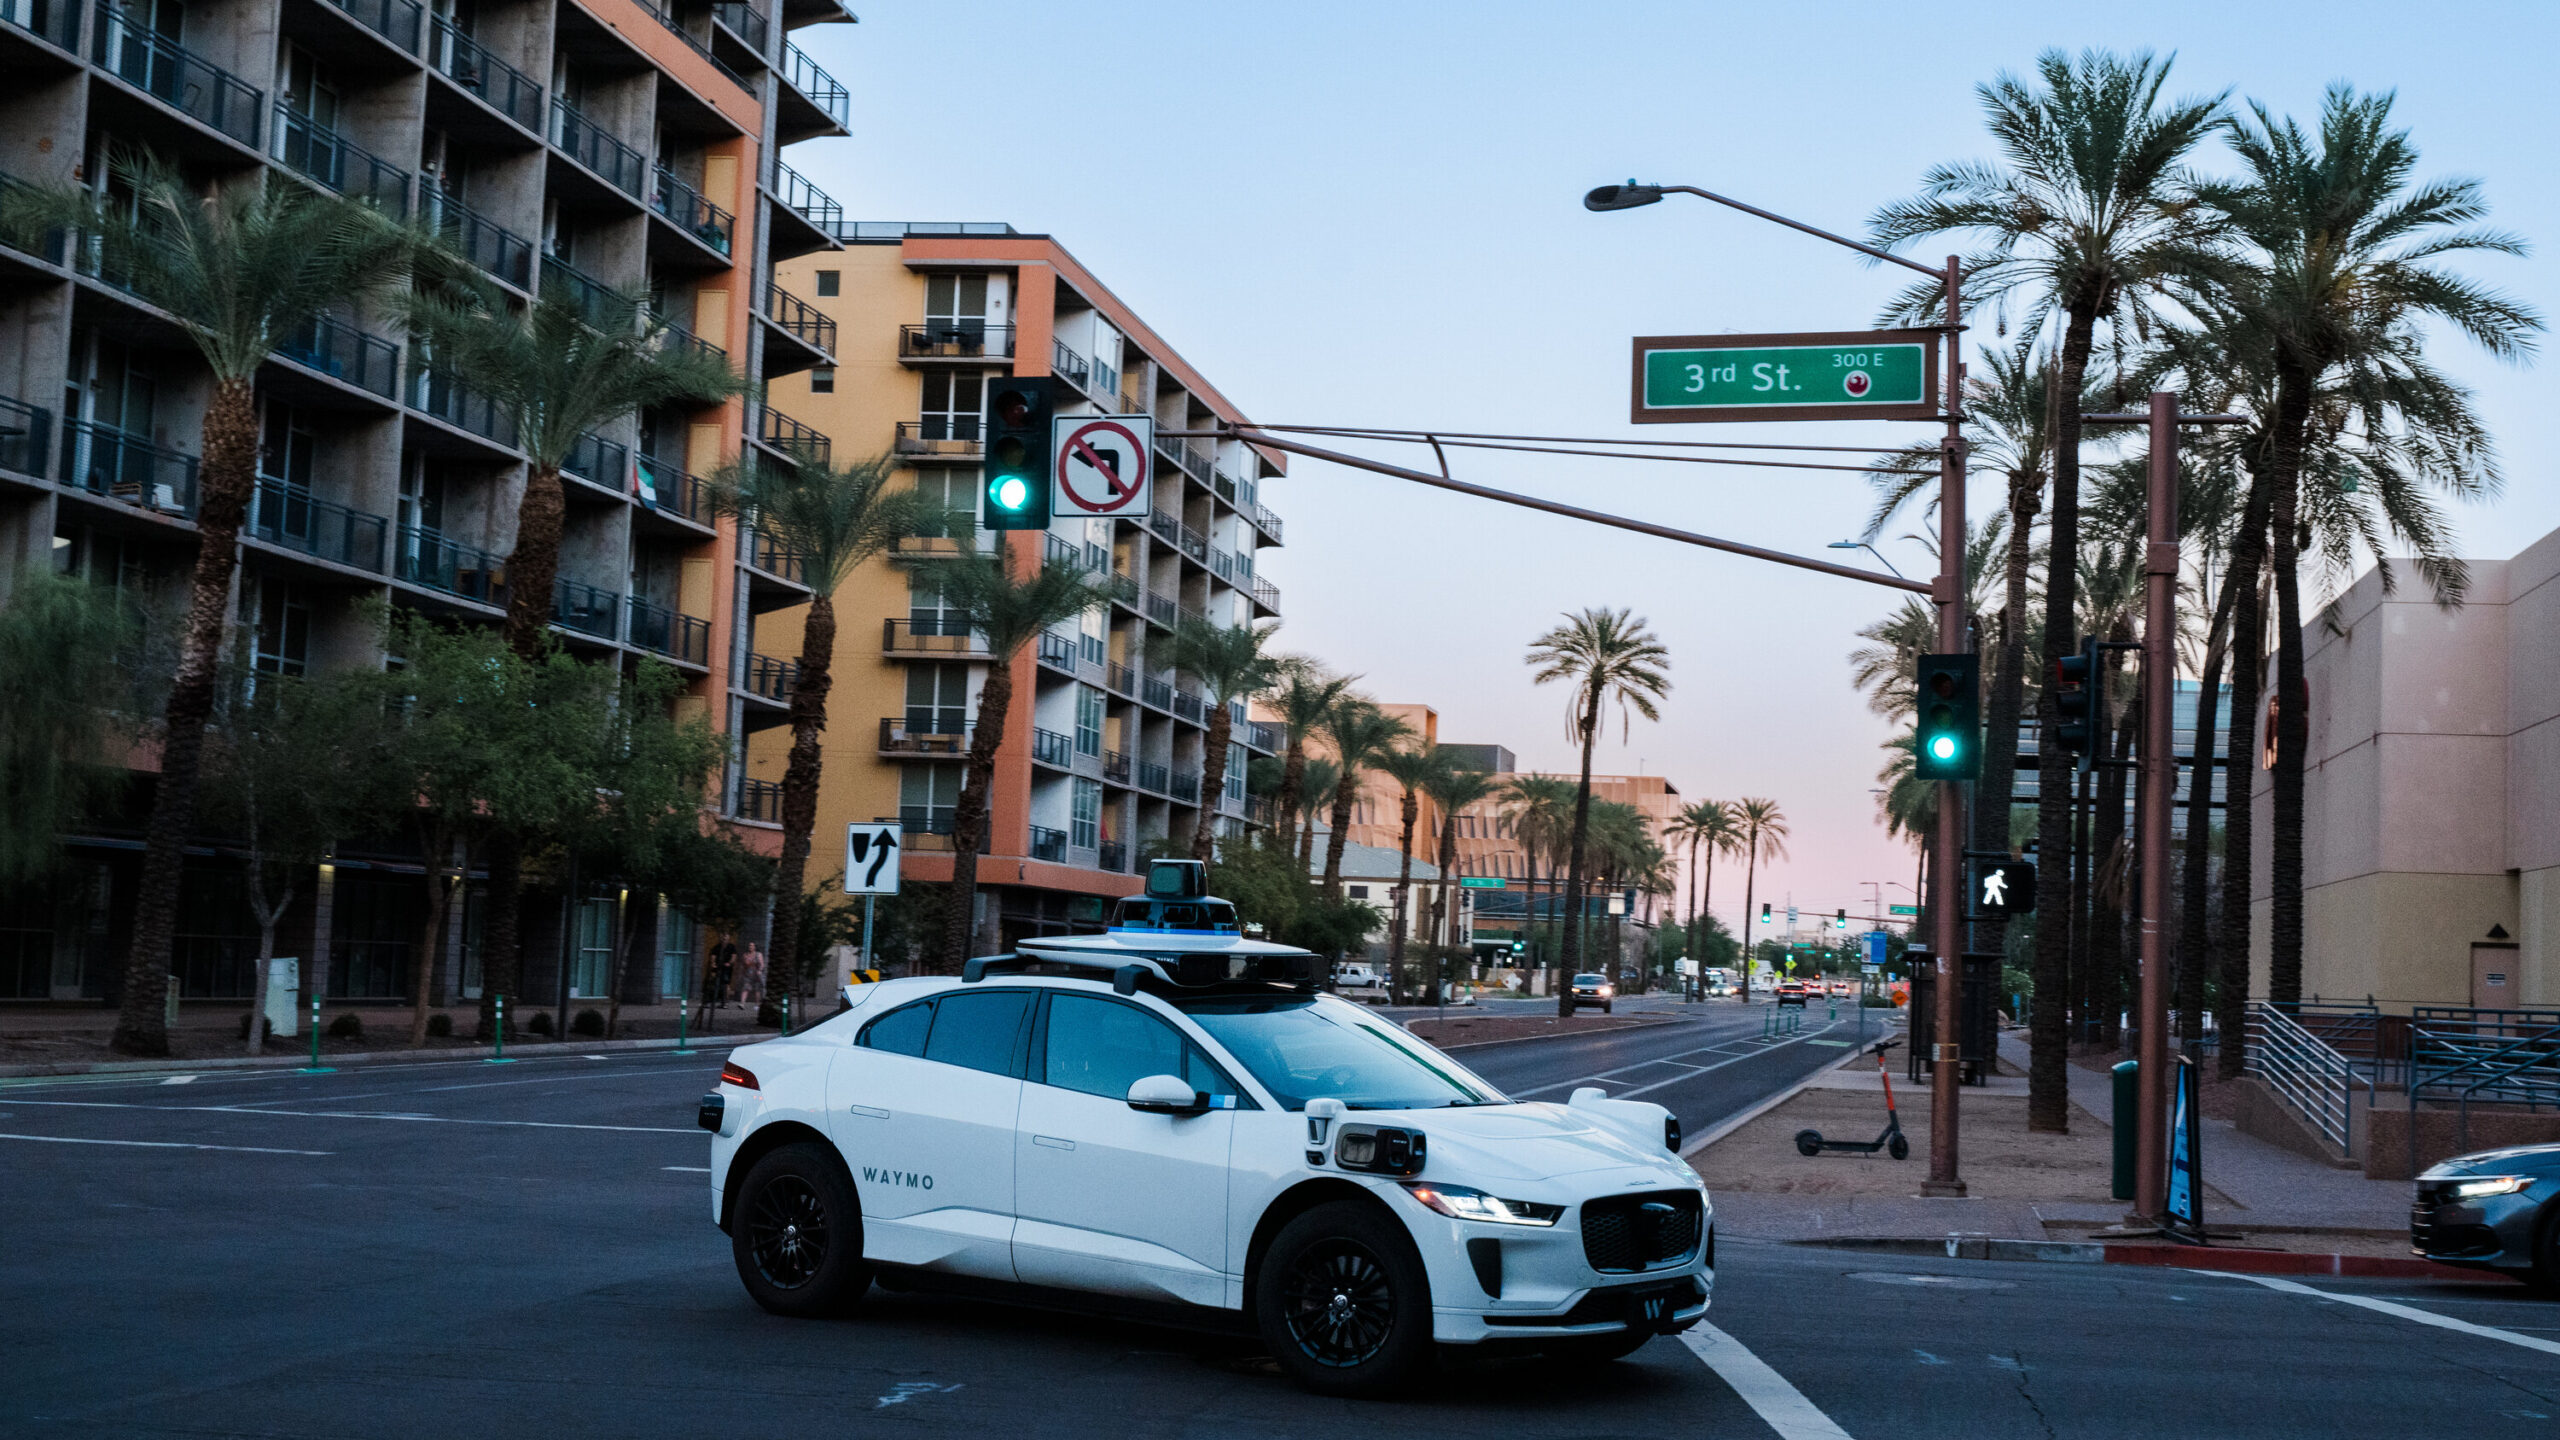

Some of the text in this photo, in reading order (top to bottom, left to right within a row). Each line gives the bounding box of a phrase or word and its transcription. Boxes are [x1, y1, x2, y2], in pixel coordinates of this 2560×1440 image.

[1832, 352, 1885, 367] 300 E
[1684, 362, 1802, 392] 3rd St.
[862, 1166, 934, 1190] WAYMO
